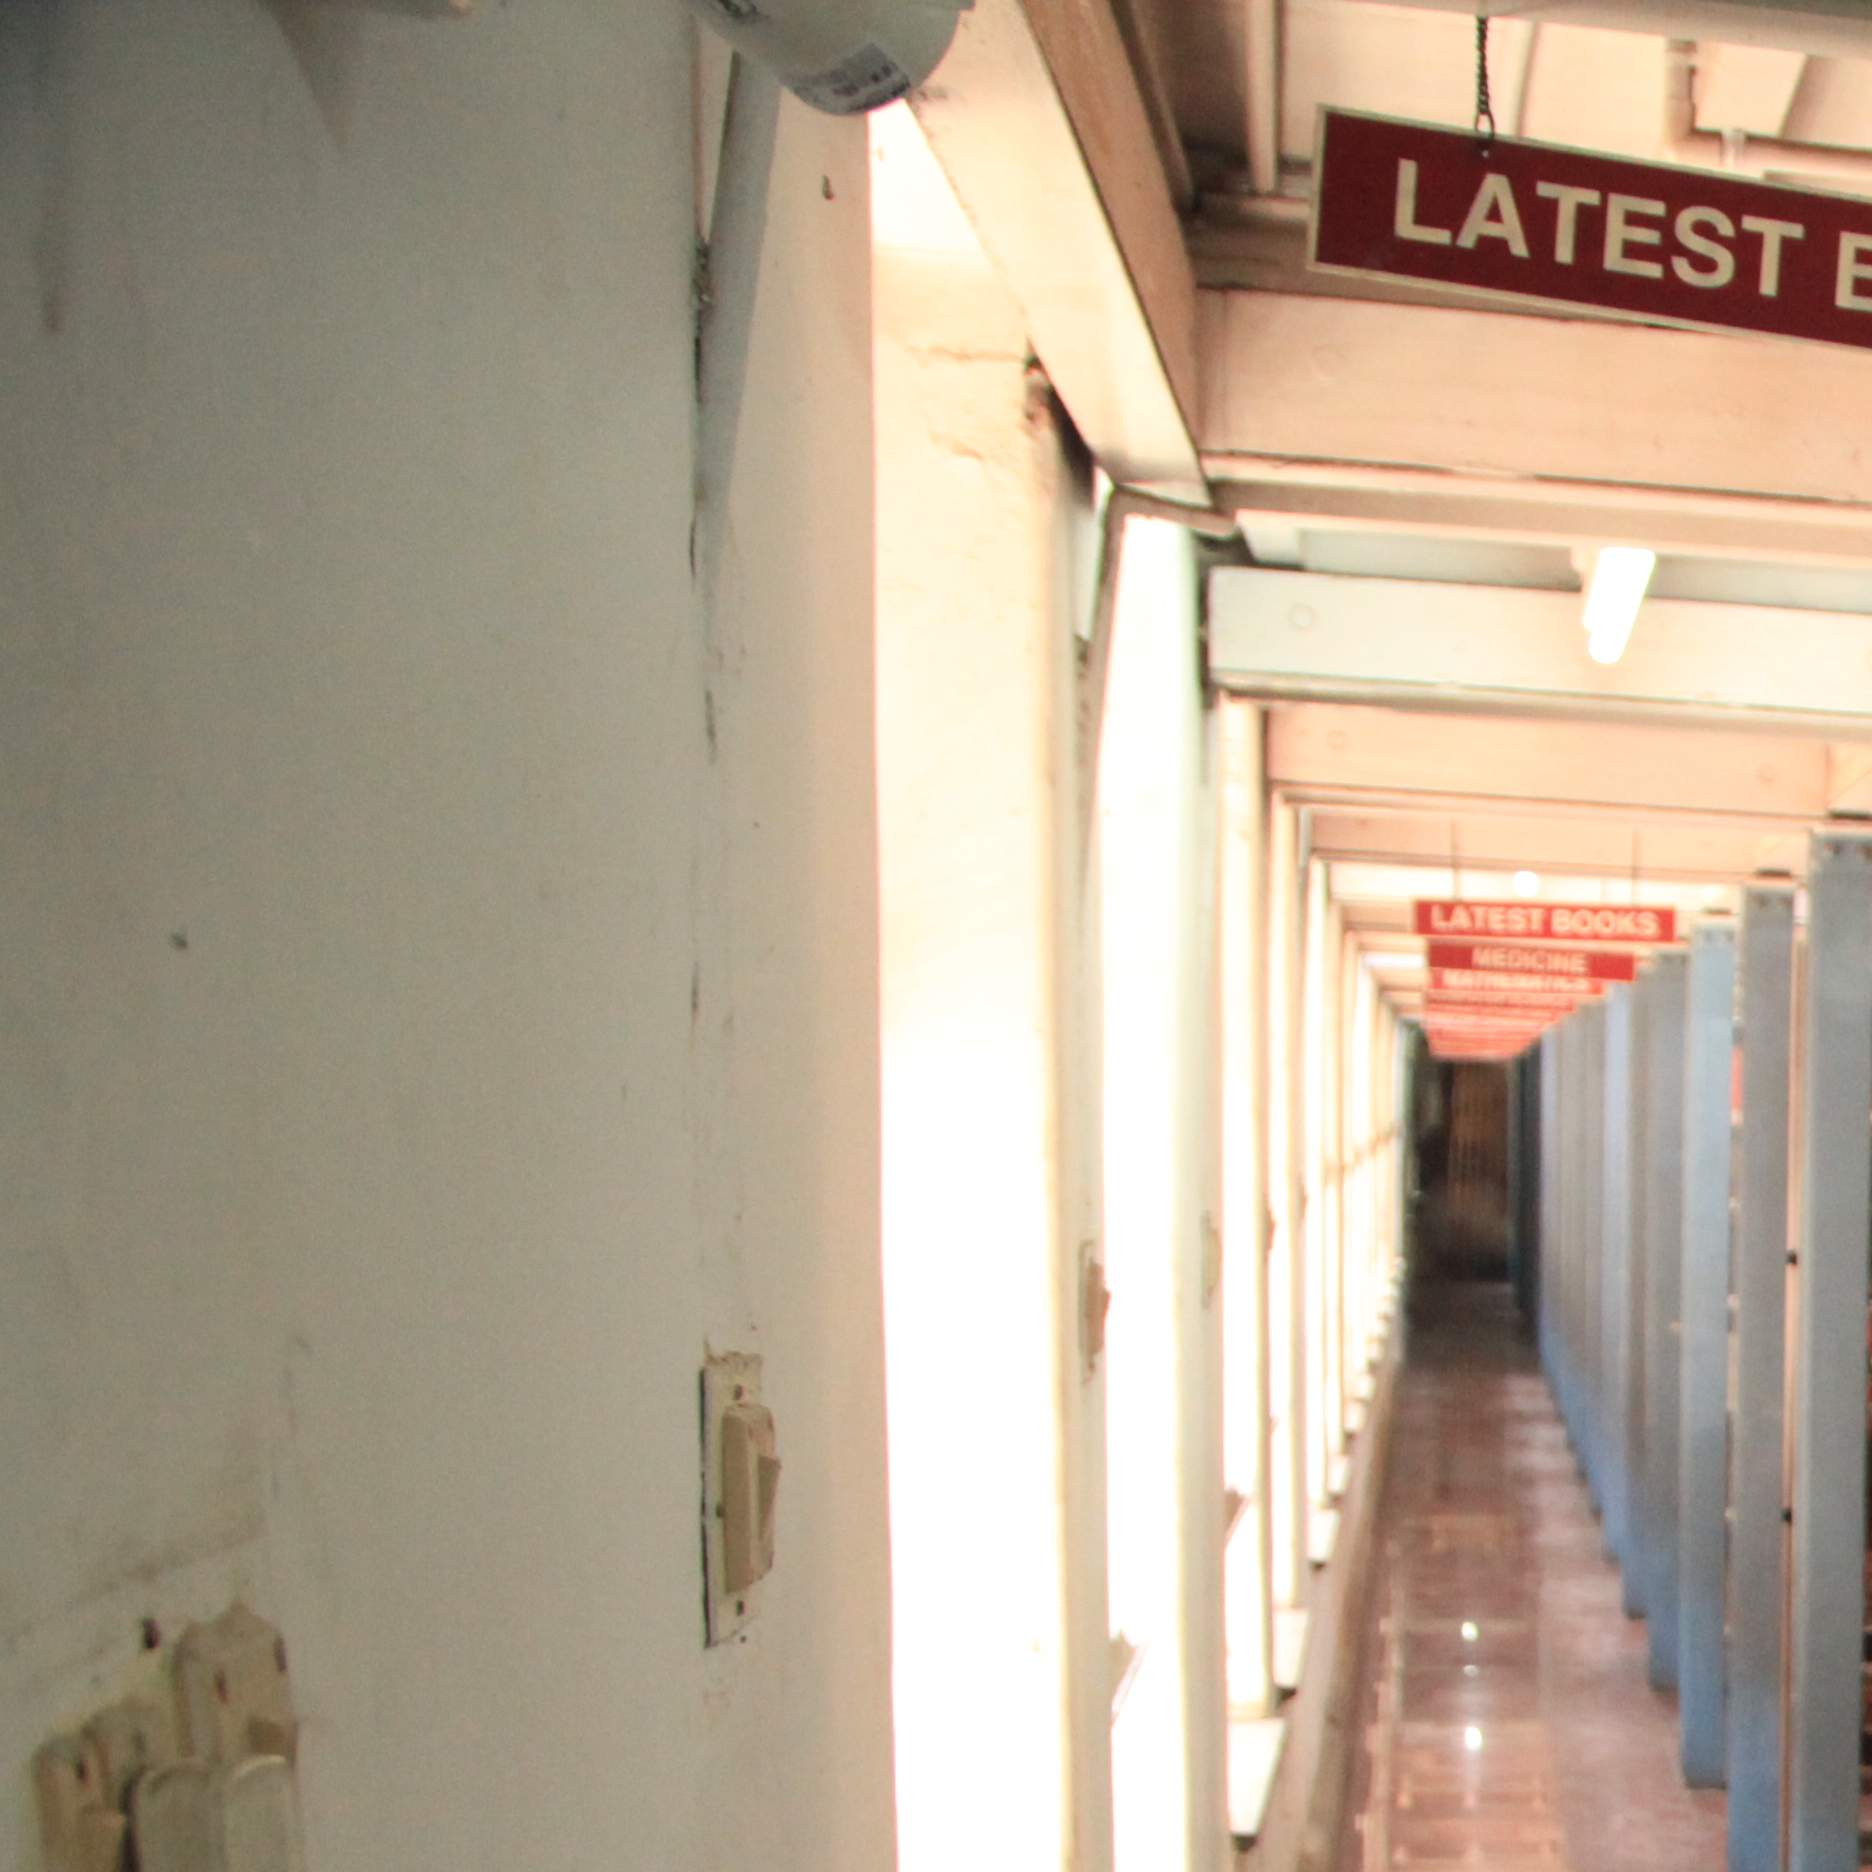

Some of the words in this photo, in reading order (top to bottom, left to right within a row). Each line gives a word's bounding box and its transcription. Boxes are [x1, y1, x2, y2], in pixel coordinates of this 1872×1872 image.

[1392, 157, 1804, 299] LATEST
[1430, 904, 1546, 933] LATEST
[1551, 908, 1660, 936] BOOKS
[1472, 947, 1589, 974] MEDICINE
